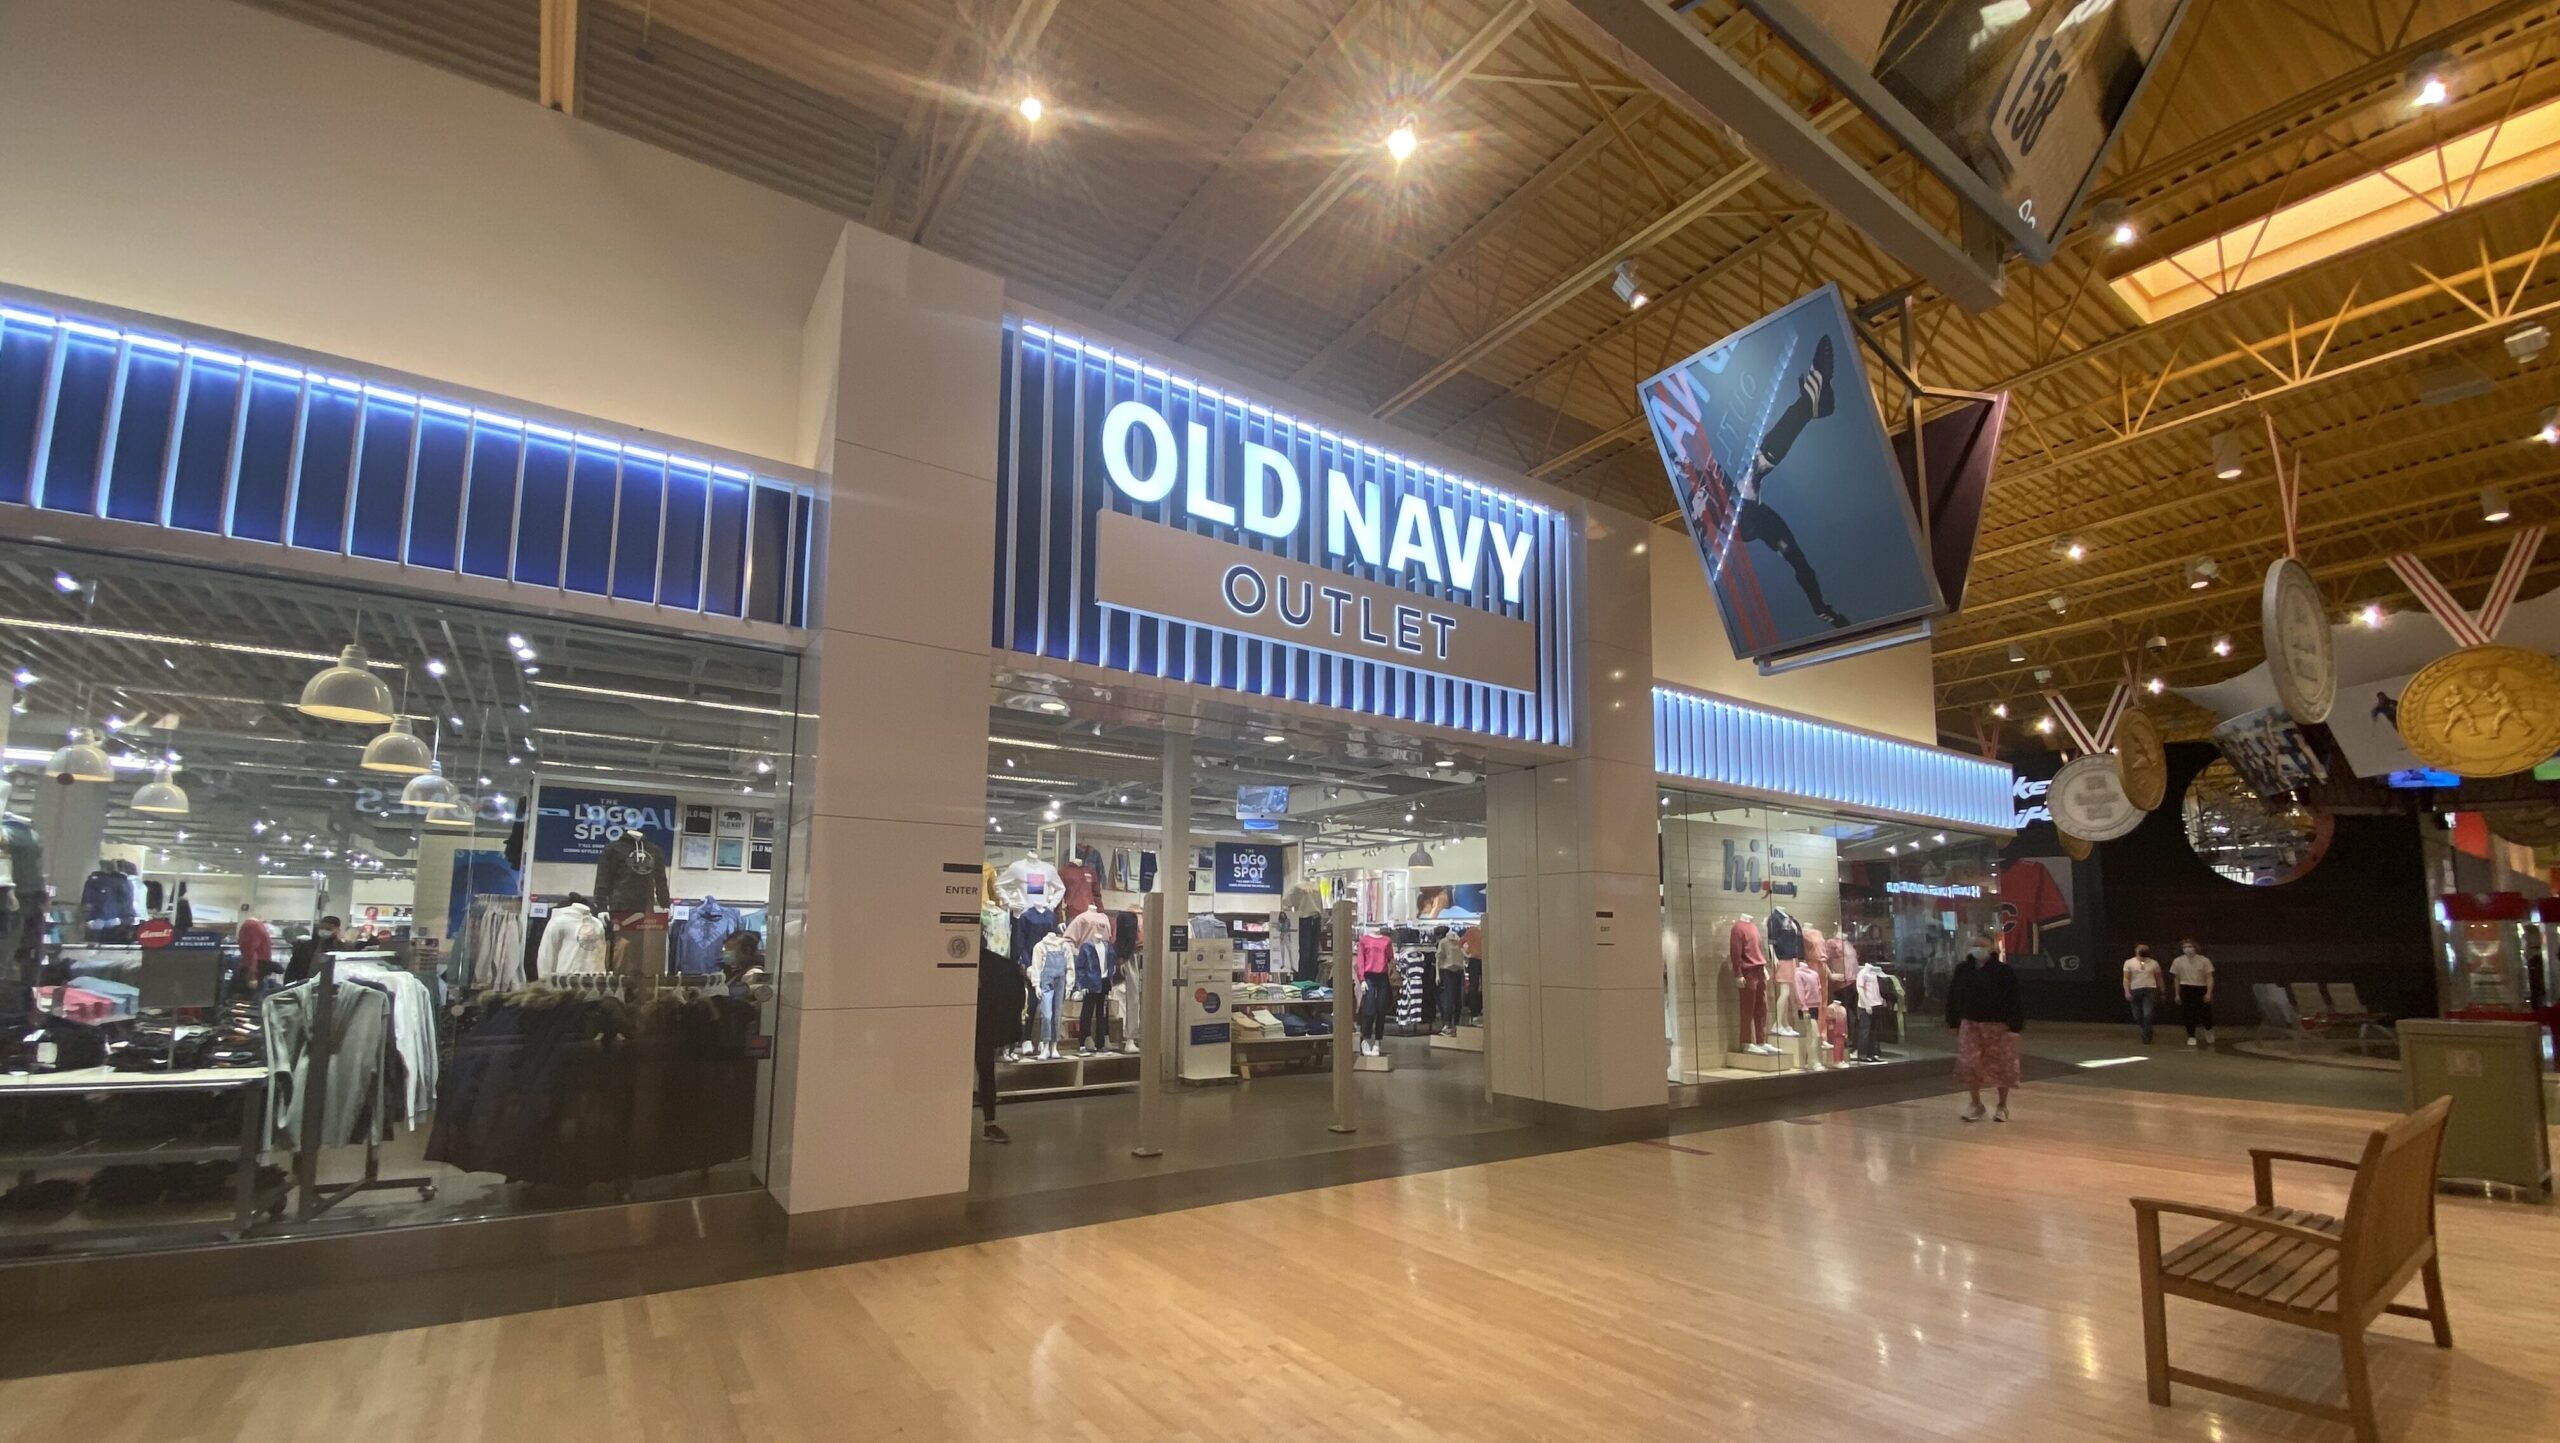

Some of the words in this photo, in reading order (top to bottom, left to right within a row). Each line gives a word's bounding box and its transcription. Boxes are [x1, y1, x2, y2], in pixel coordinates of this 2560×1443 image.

[1102, 400, 1301, 538] OLD
[1328, 469, 1534, 604] NAVY
[1222, 563, 1457, 659] OUTLET
[574, 804, 641, 821] LOGO
[1233, 853, 1266, 865] LOGO
[1233, 866, 1265, 879] SPOT
[945, 885, 979, 895] ENTER
